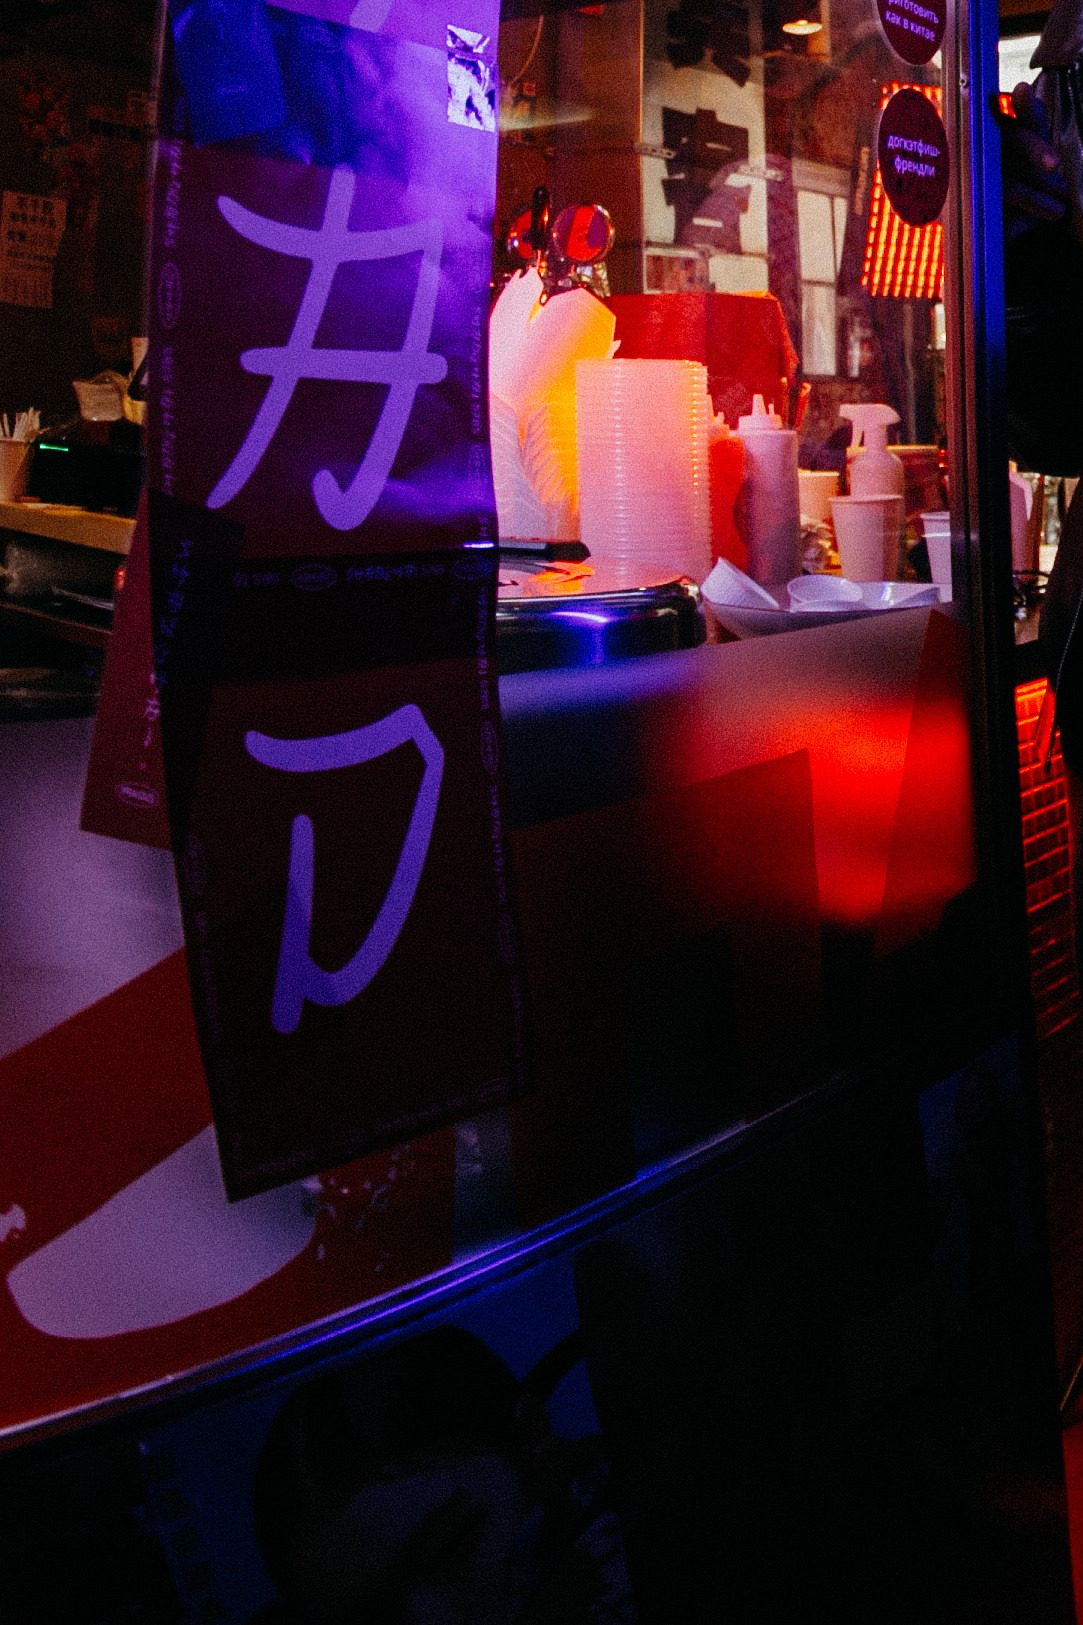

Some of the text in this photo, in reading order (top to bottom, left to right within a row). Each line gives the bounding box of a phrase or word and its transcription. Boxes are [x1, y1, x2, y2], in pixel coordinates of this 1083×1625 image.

[884, 9, 936, 43] как в китае
[894, 154, 936, 178] френдли
